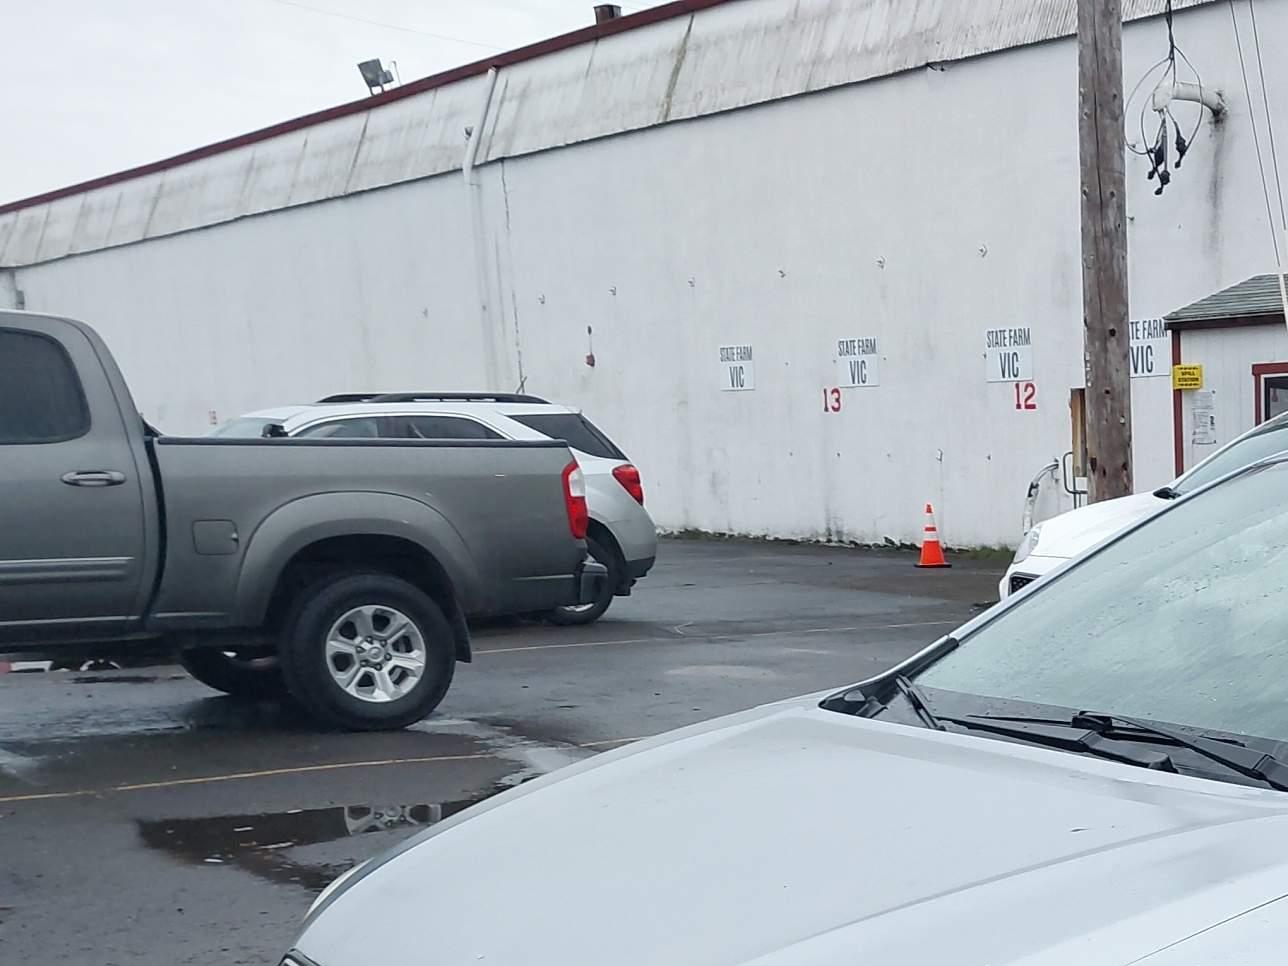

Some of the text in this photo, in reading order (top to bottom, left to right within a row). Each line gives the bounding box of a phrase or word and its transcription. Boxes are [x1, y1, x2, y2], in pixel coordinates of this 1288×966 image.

[838, 337, 877, 356] STATE FARM
[986, 327, 1031, 348] STATE FARM
[720, 347, 735, 362] STATE
[999, 352, 1019, 379] VIC
[1130, 345, 1153, 374] VIC
[729, 366, 745, 388] VIC
[849, 360, 867, 385] VIC
[823, 387, 841, 412] 13
[1015, 382, 1037, 409] 12
